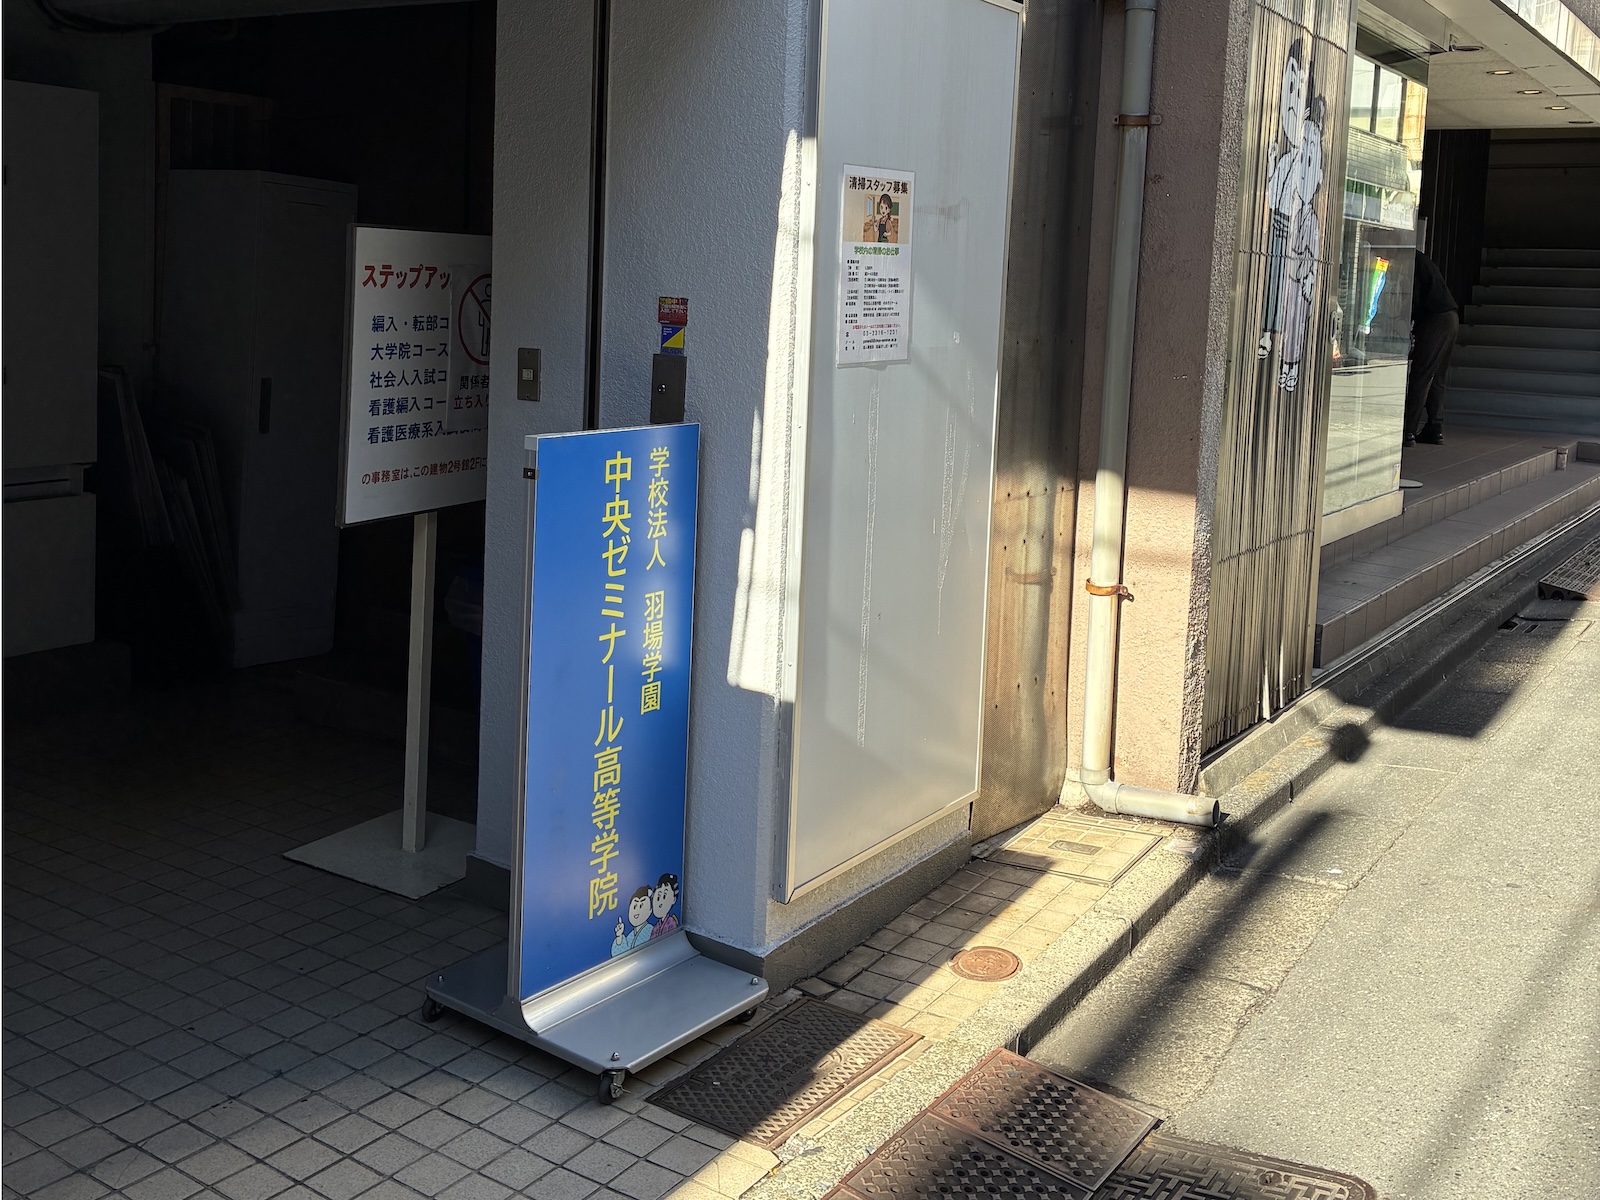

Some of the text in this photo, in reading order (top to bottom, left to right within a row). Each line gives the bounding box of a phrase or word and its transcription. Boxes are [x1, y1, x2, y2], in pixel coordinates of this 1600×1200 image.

[849, 176, 908, 194] 清掃スタッフ募集
[362, 264, 450, 289] ステップアッ
[370, 342, 449, 361] 大学院コース
[369, 369, 447, 389] 社会人入試コ
[640, 446, 670, 715] 学校法人 羽場学園
[588, 450, 632, 920] 中央ゼミナール高等学院
